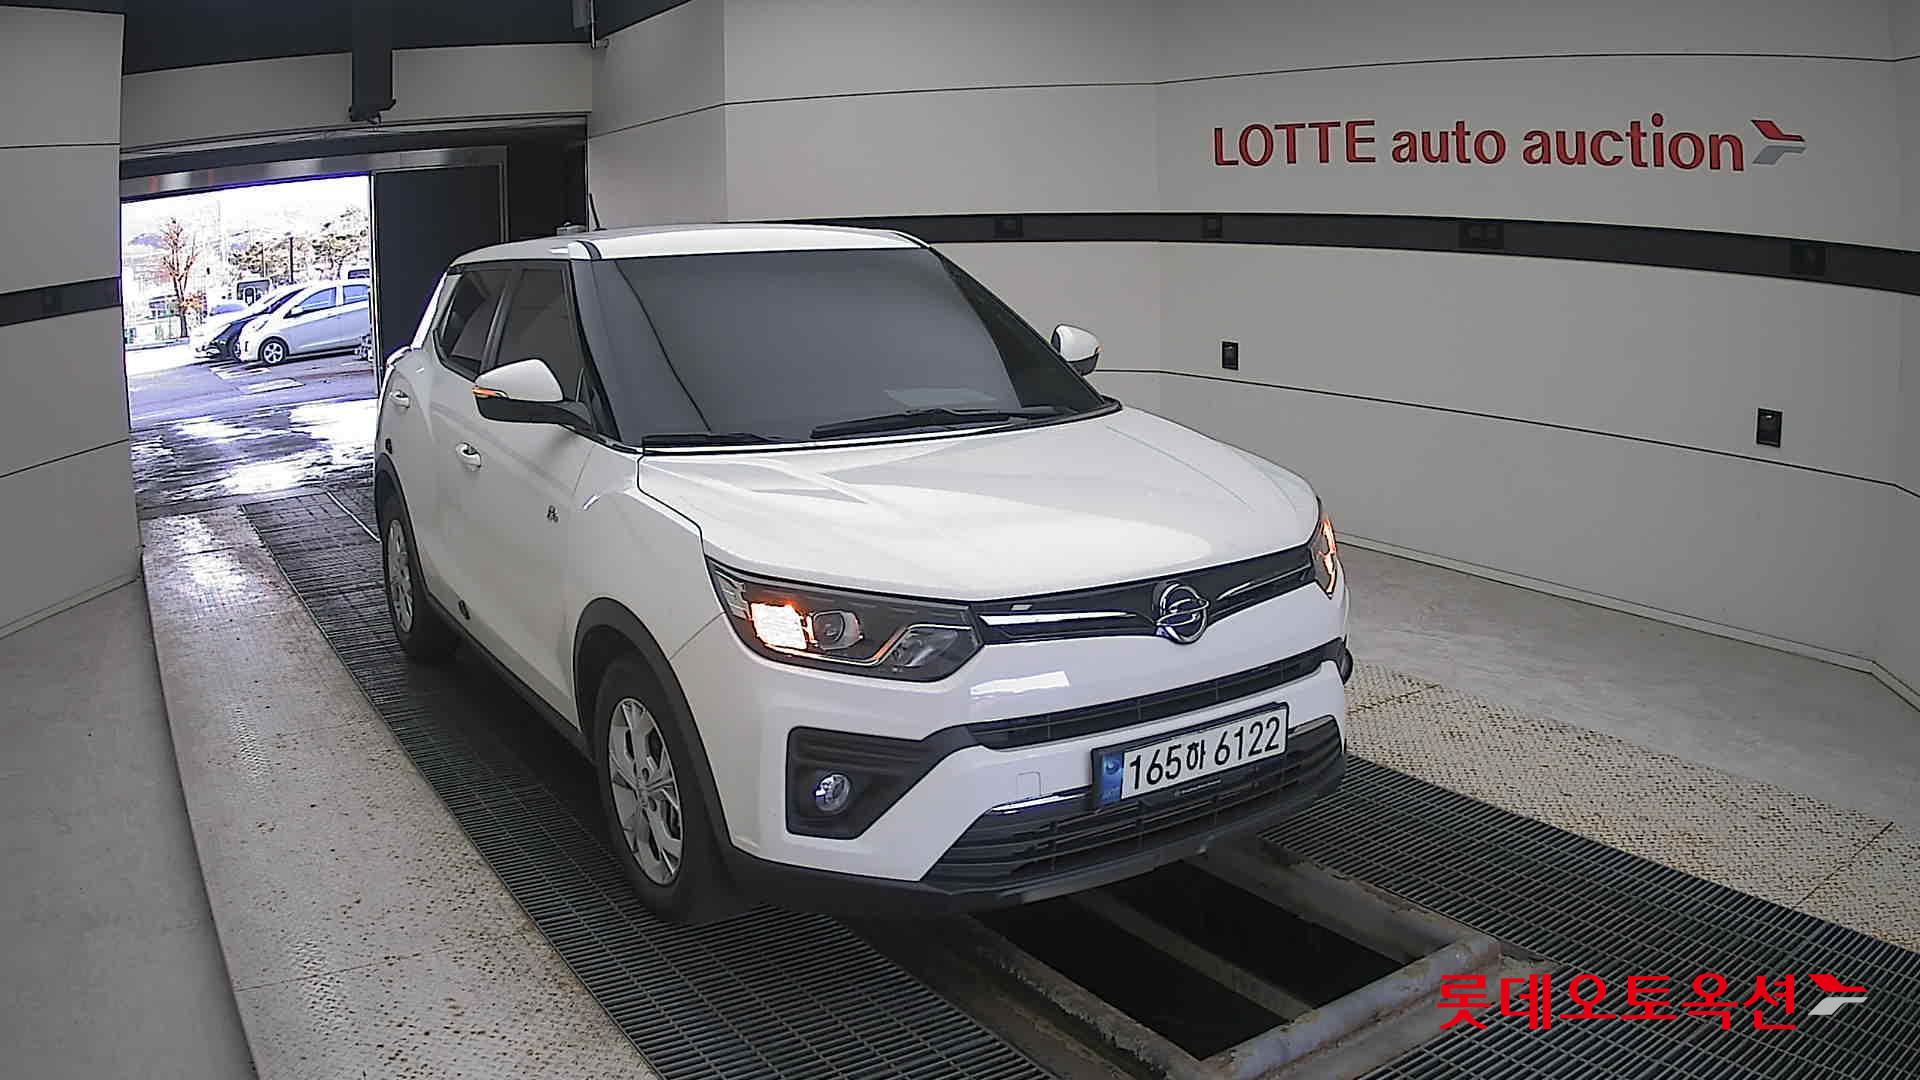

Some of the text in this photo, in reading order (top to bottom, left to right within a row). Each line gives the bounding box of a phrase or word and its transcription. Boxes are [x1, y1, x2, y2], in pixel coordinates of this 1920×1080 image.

[1213, 113, 1745, 172] LOTTE auto auction
[1129, 716, 1281, 790] 165하 6122
